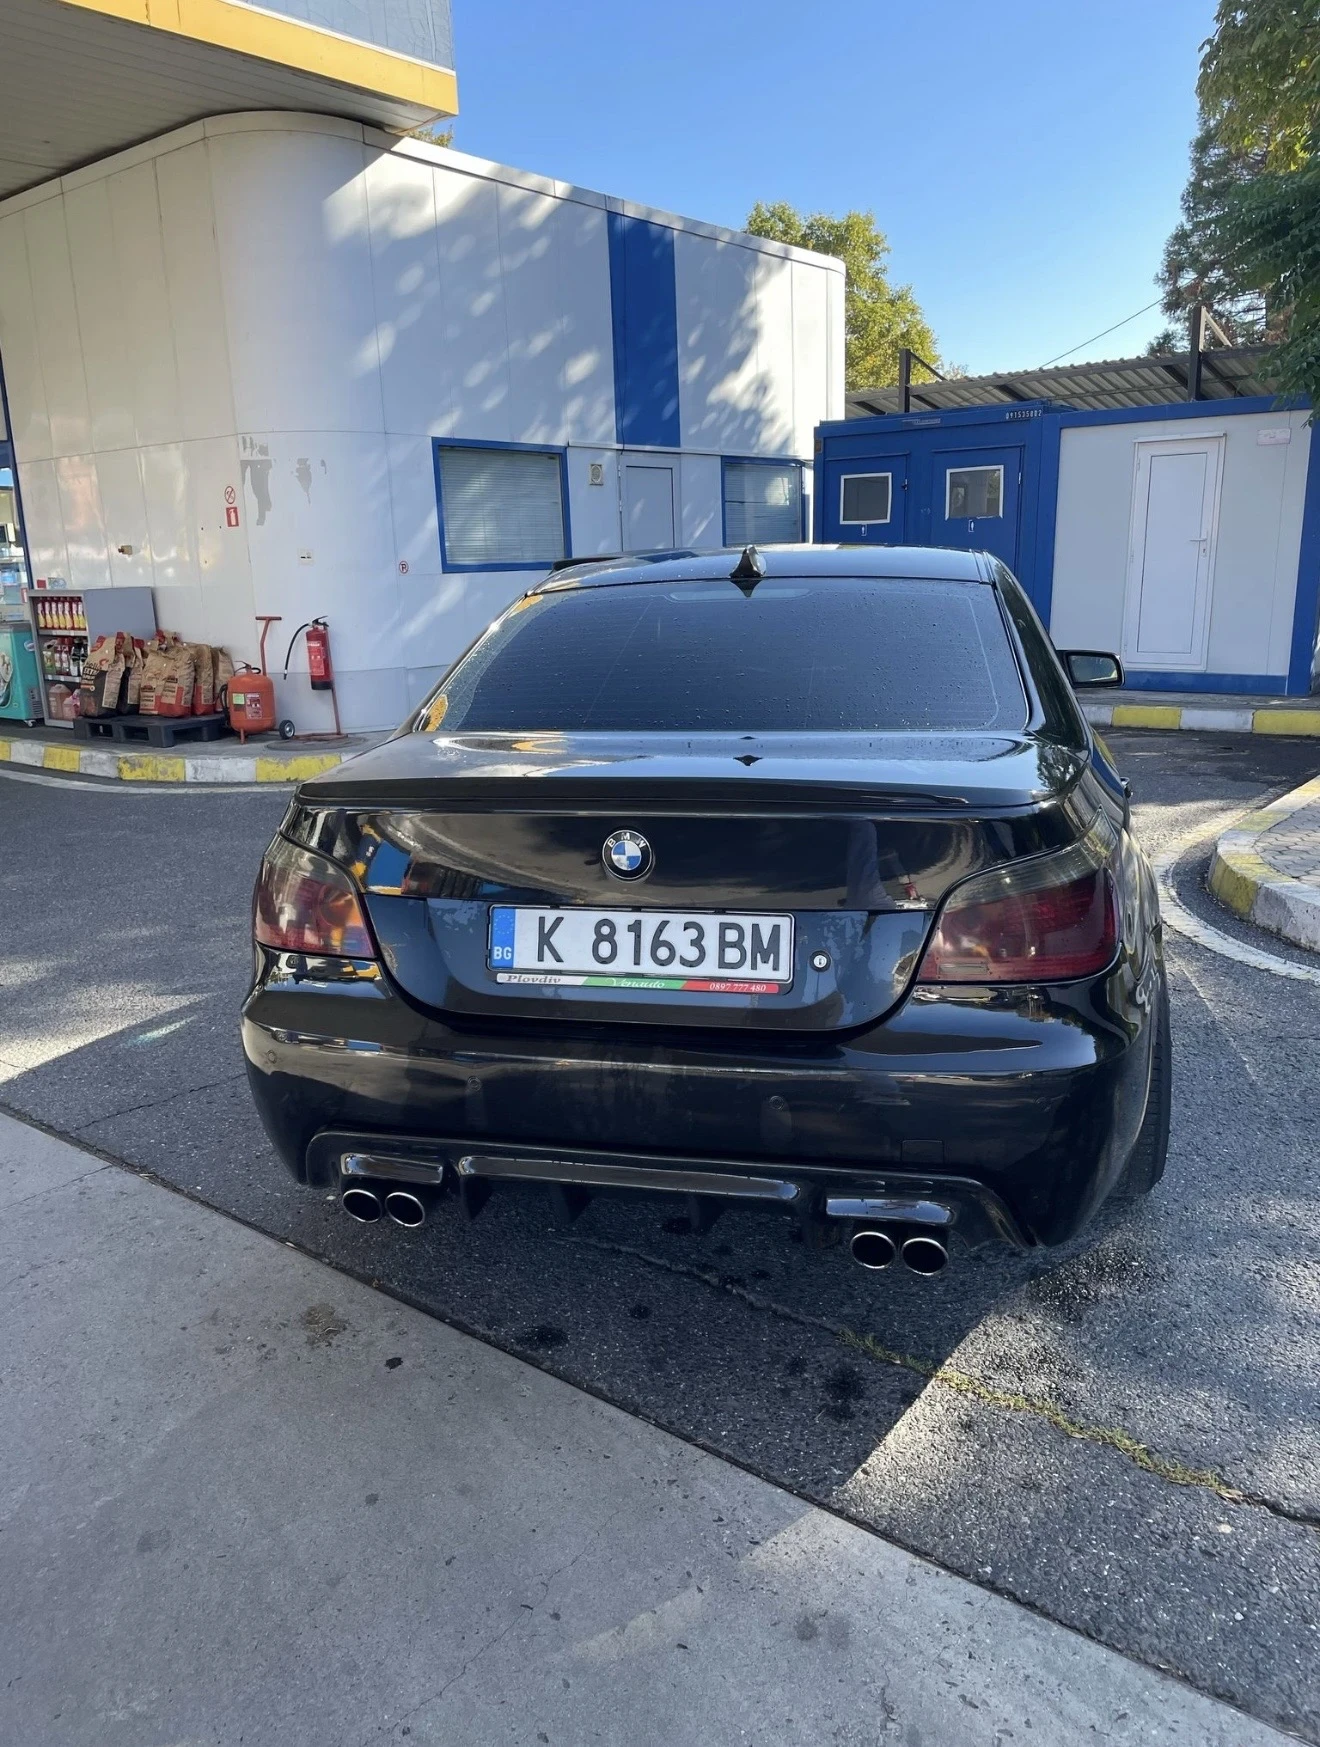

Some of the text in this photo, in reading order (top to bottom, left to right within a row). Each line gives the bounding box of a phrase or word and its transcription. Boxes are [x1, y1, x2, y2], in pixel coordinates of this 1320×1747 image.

[607, 832, 647, 848] BMW
[537, 916, 565, 963] K
[493, 946, 513, 960] BG
[506, 974, 562, 984] Plovdiv
[709, 981, 731, 991] 0897
[733, 983, 750, 991] 777
[750, 983, 767, 993] 480
